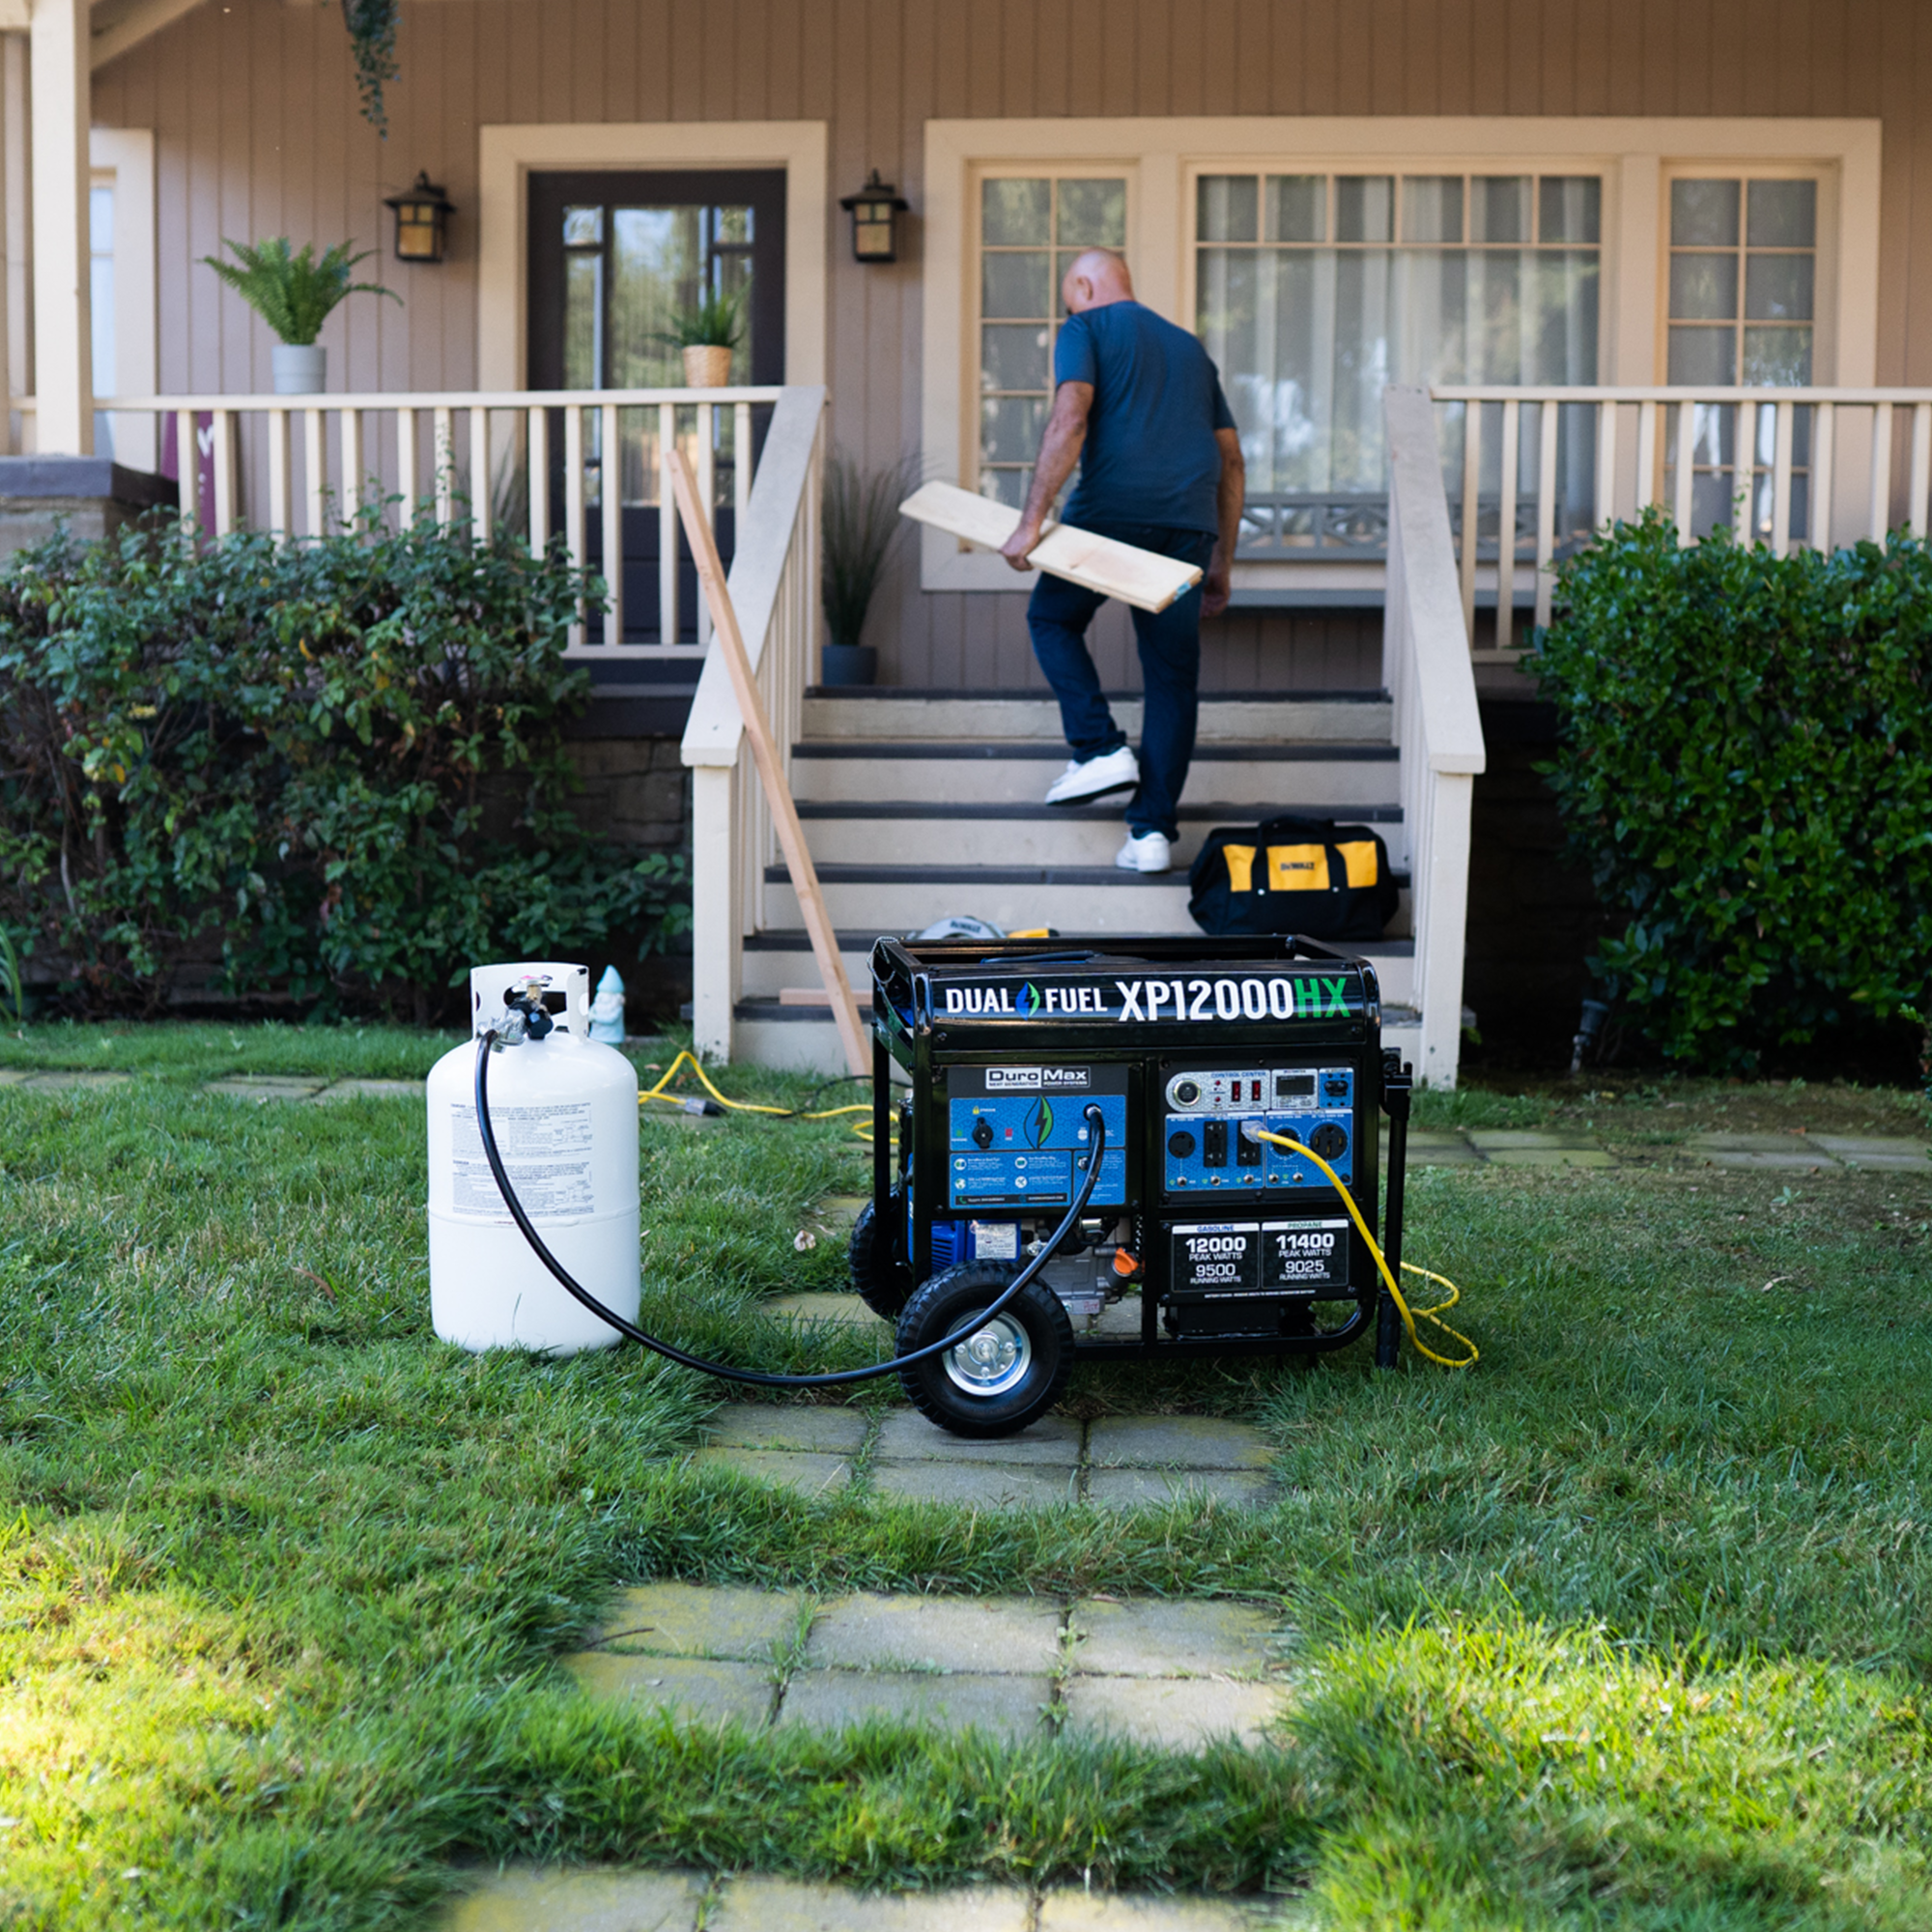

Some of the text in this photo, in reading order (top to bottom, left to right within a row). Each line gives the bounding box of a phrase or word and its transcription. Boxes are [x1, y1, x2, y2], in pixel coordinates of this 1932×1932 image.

[946, 978, 1350, 1022] DUAL FUEL XP12000HX
[988, 1068, 1087, 1082] Duro Max
[1185, 1236, 1246, 1253] 12000
[1276, 1233, 1335, 1249] 11400
[1189, 1252, 1242, 1262] PEAK WATTS
[1278, 1248, 1332, 1258] PEAK WATTS
[1196, 1264, 1236, 1277] 9500
[1285, 1260, 1324, 1273] 9025
